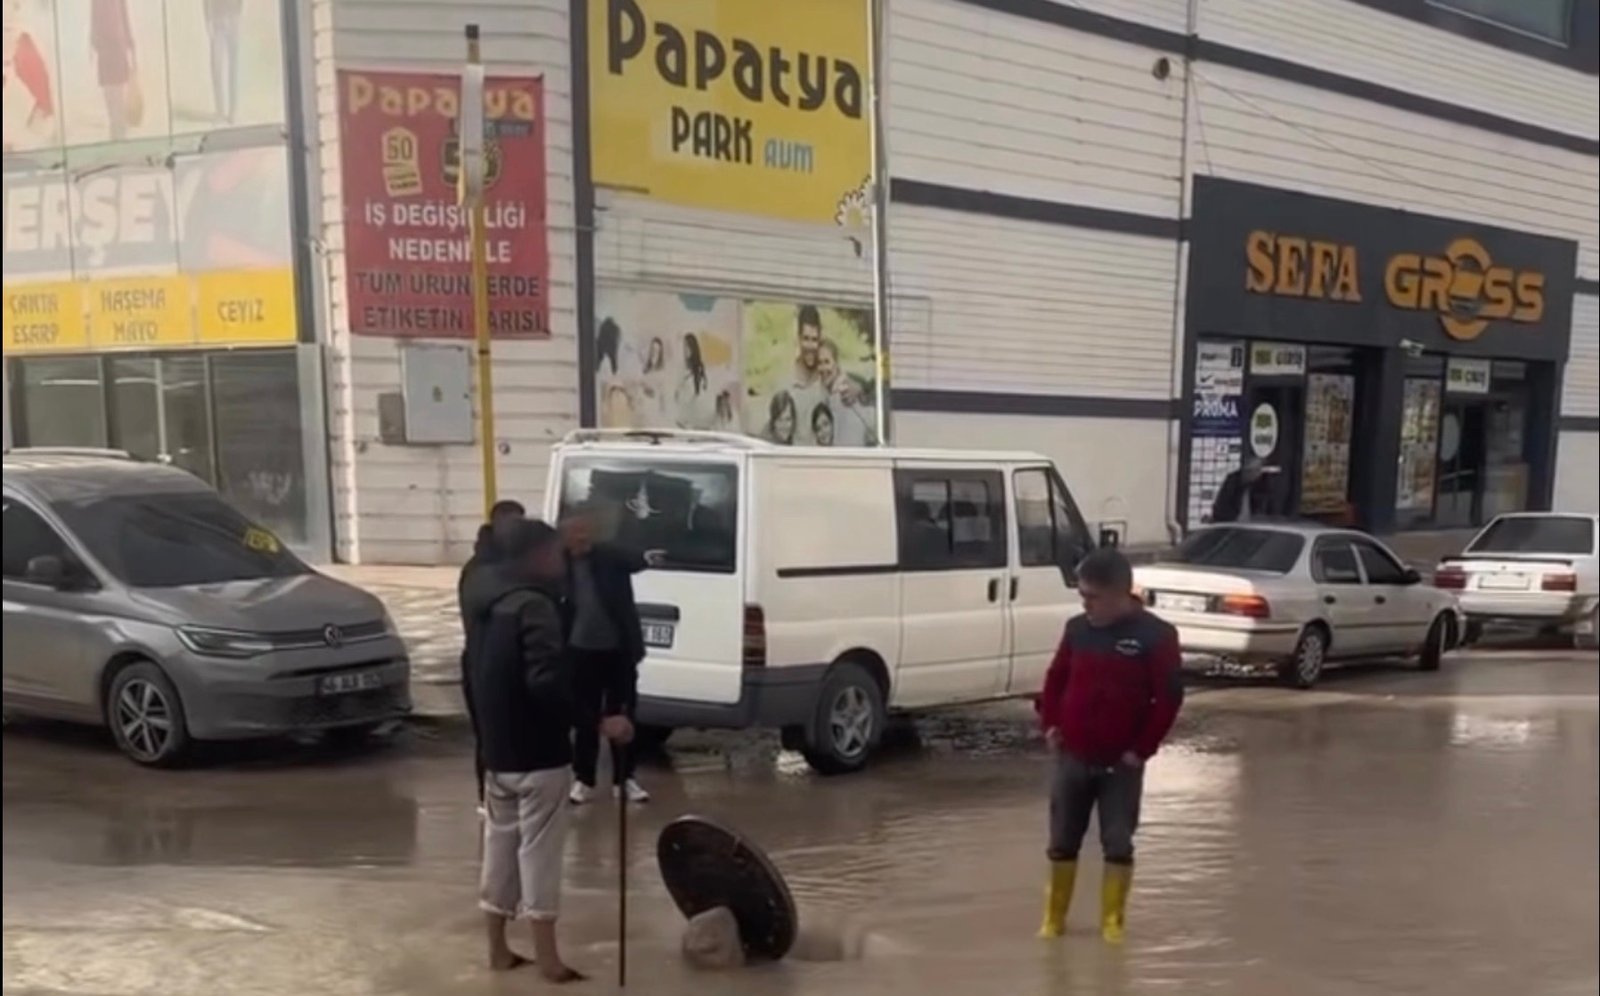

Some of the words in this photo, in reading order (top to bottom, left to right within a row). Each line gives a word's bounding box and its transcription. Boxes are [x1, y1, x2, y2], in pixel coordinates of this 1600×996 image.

[606, 0, 862, 120] Papatya
[349, 75, 535, 121] Papaya
[672, 105, 753, 165] PARK
[365, 200, 386, 226] İŞ
[389, 236, 512, 263] NEDENİLE
[1245, 229, 1362, 302] SEFA
[1385, 238, 1545, 341] GROSS
[482, 309, 541, 332] ARISI
